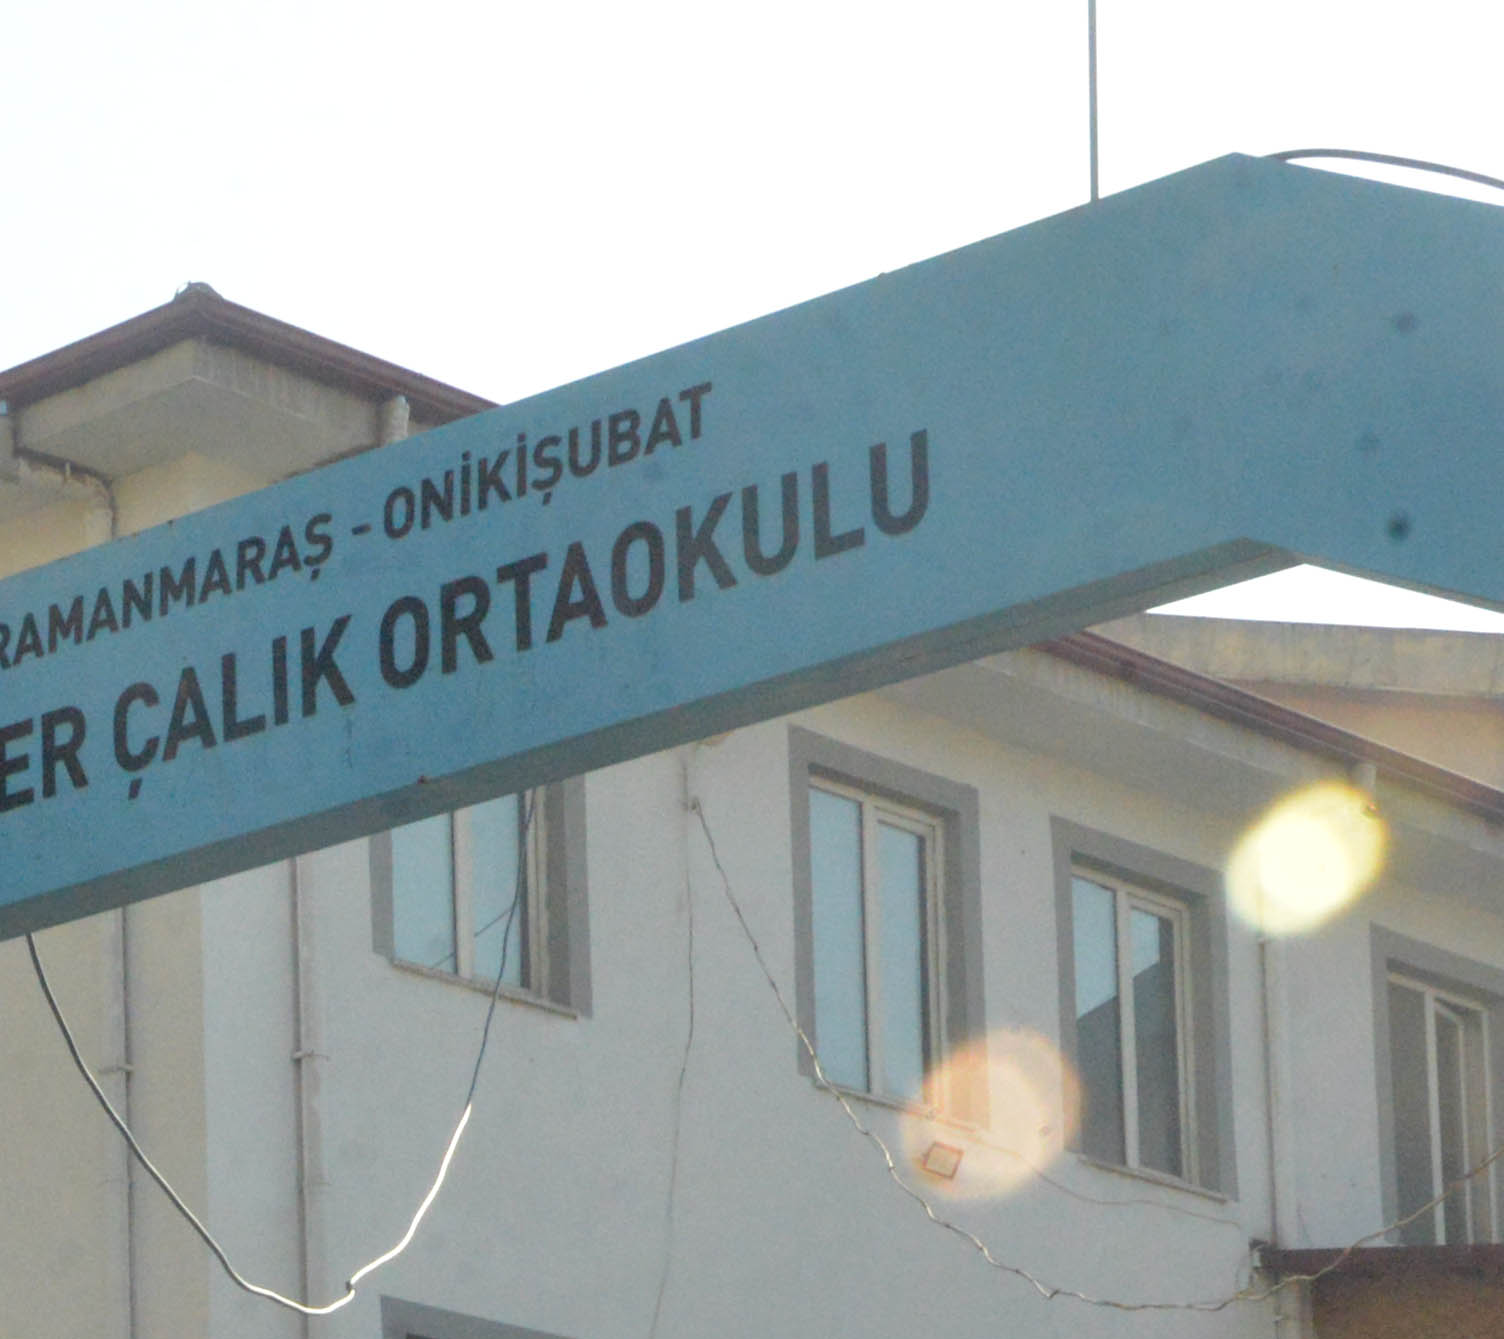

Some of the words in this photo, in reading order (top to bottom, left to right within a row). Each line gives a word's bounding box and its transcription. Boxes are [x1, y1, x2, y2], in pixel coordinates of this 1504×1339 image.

[382, 381, 714, 541] ONİKİŞUBAT
[112, 614, 355, 804] ÇALIK
[378, 429, 931, 691] ORTAOKULU
